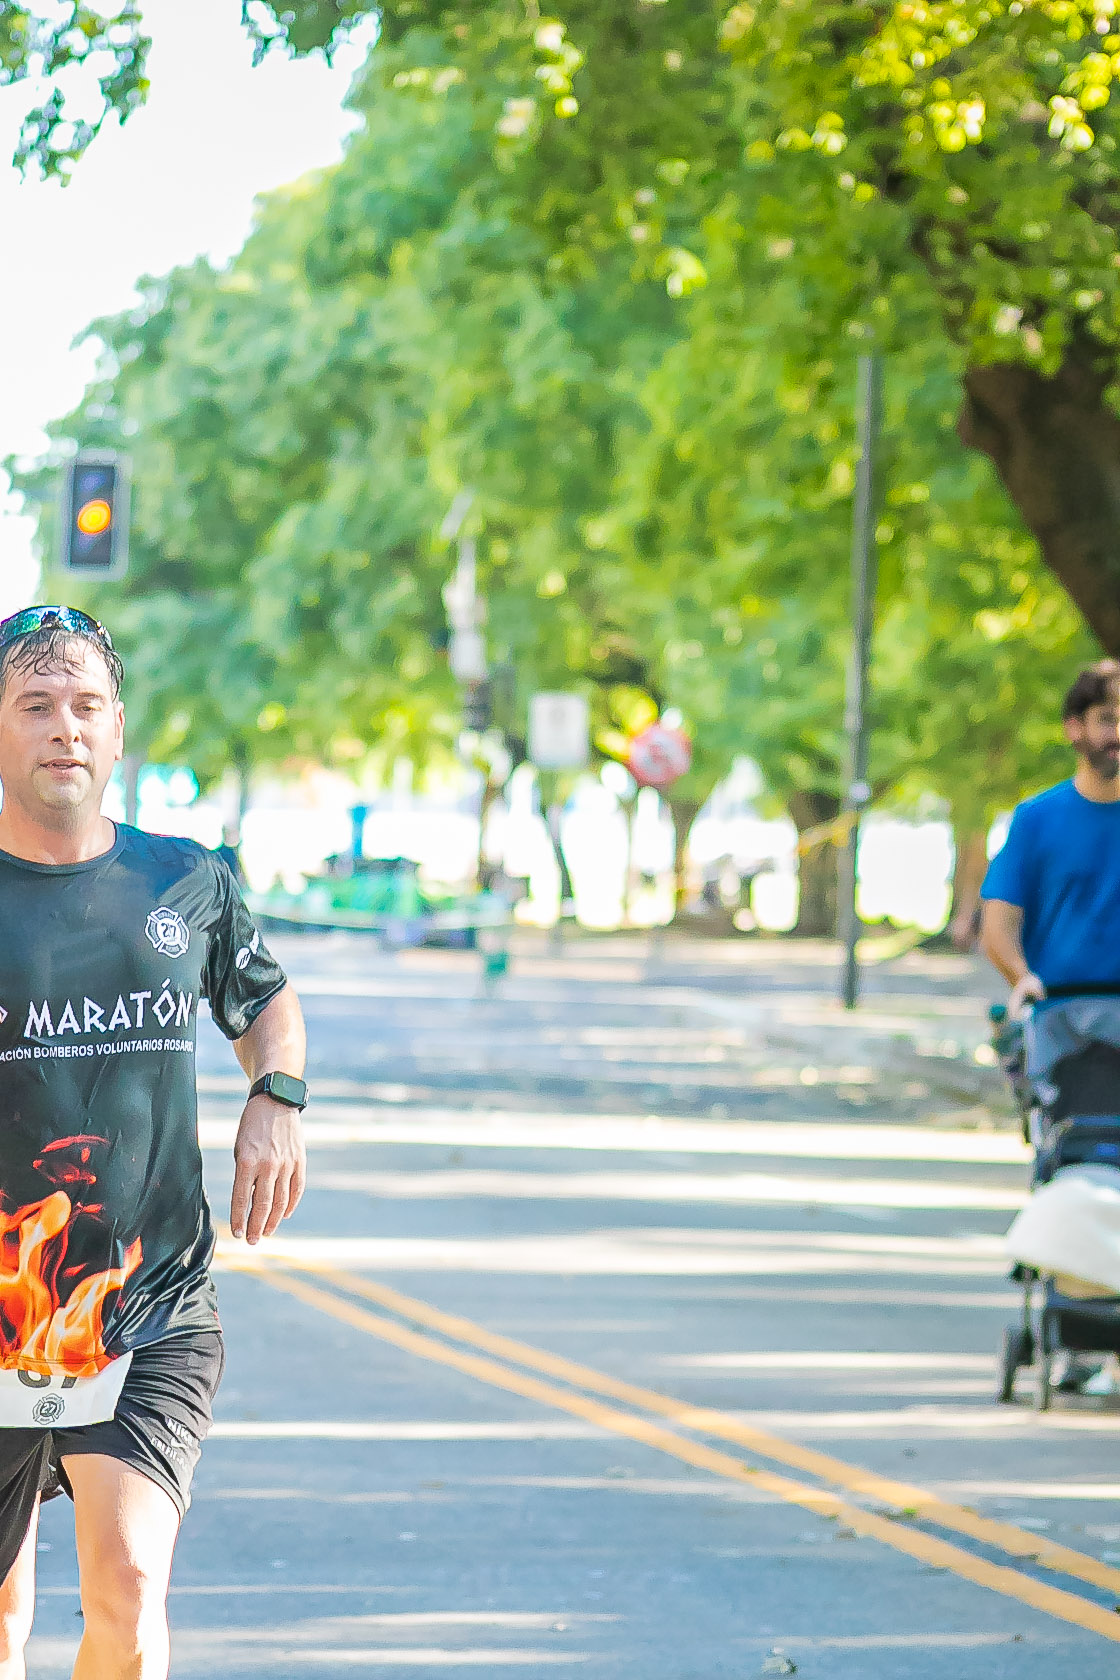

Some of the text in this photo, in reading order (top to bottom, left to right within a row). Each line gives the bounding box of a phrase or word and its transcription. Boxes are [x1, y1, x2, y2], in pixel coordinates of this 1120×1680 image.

[160, 922, 177, 938] 27
[23, 977, 193, 1038] MARATÓN
[33, 1045, 94, 1059] BOMBEROS
[96, 1038, 163, 1056] VOLUNTARIOS
[163, 1038, 194, 1052] ROSARIO
[41, 1402, 56, 1415] 27
